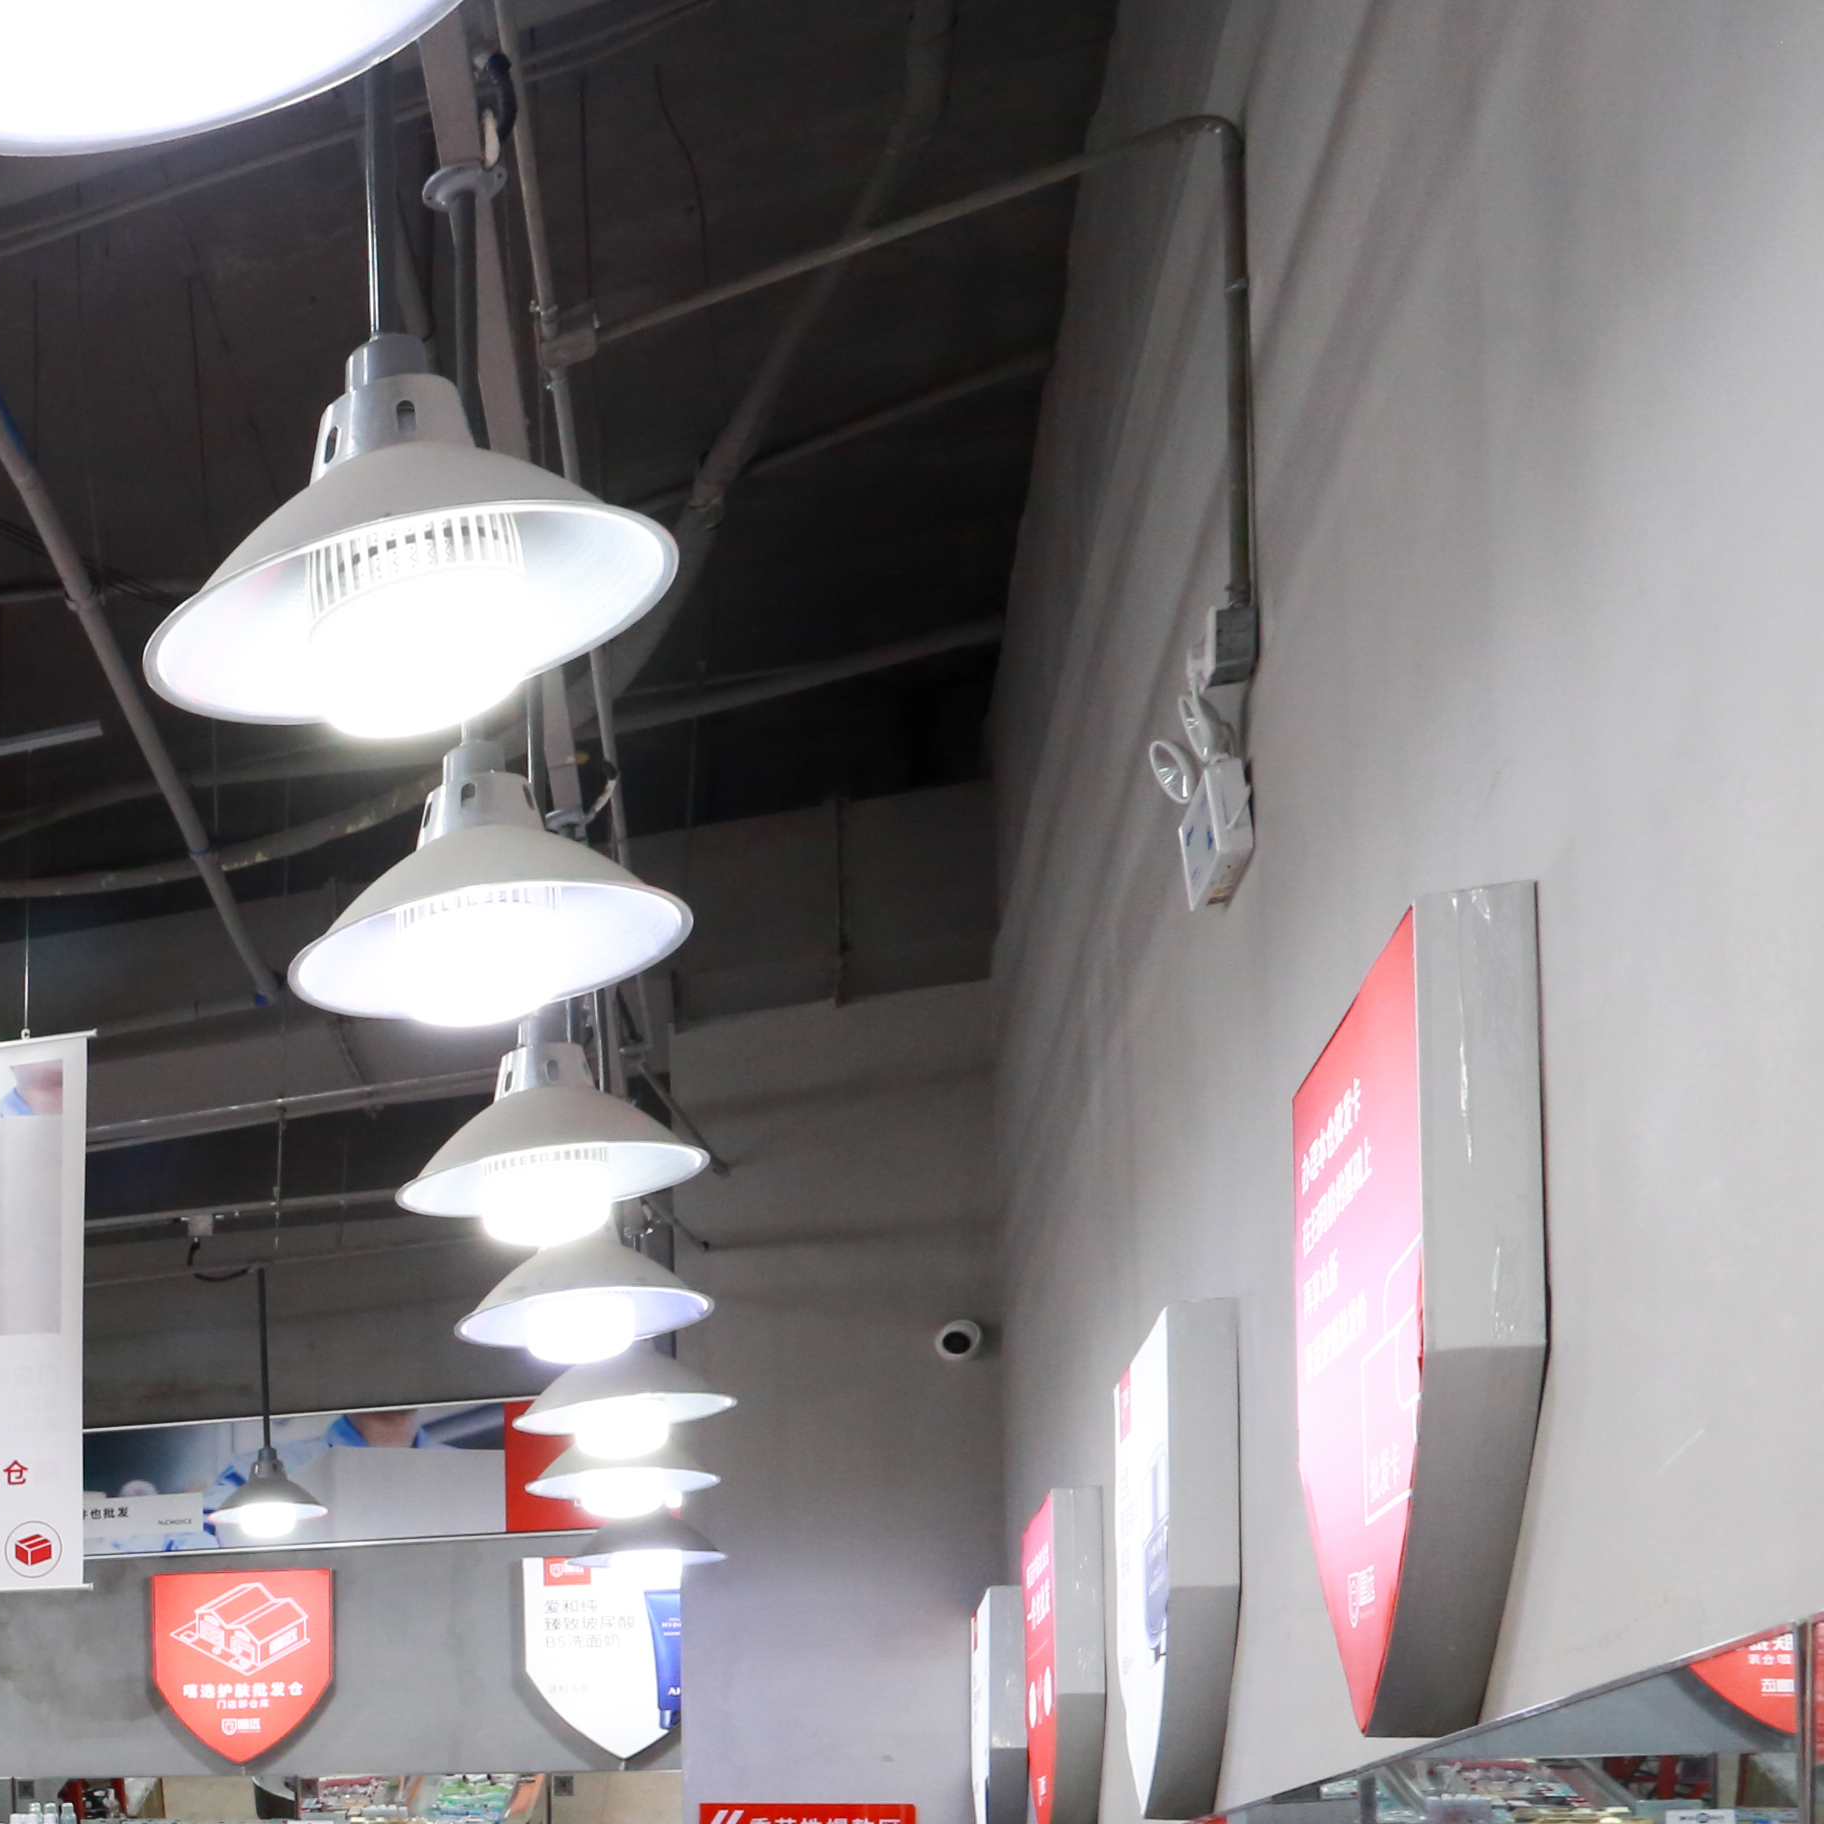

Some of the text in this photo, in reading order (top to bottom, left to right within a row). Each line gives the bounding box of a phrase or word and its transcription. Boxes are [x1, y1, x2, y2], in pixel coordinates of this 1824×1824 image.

[545, 1600, 598, 1614] 爱和纯
[545, 1616, 635, 1631] 臻致玻尿酸
[183, 1681, 303, 1699] 嘻选护肤批发仓
[216, 1699, 270, 1709] 门店即仓库
